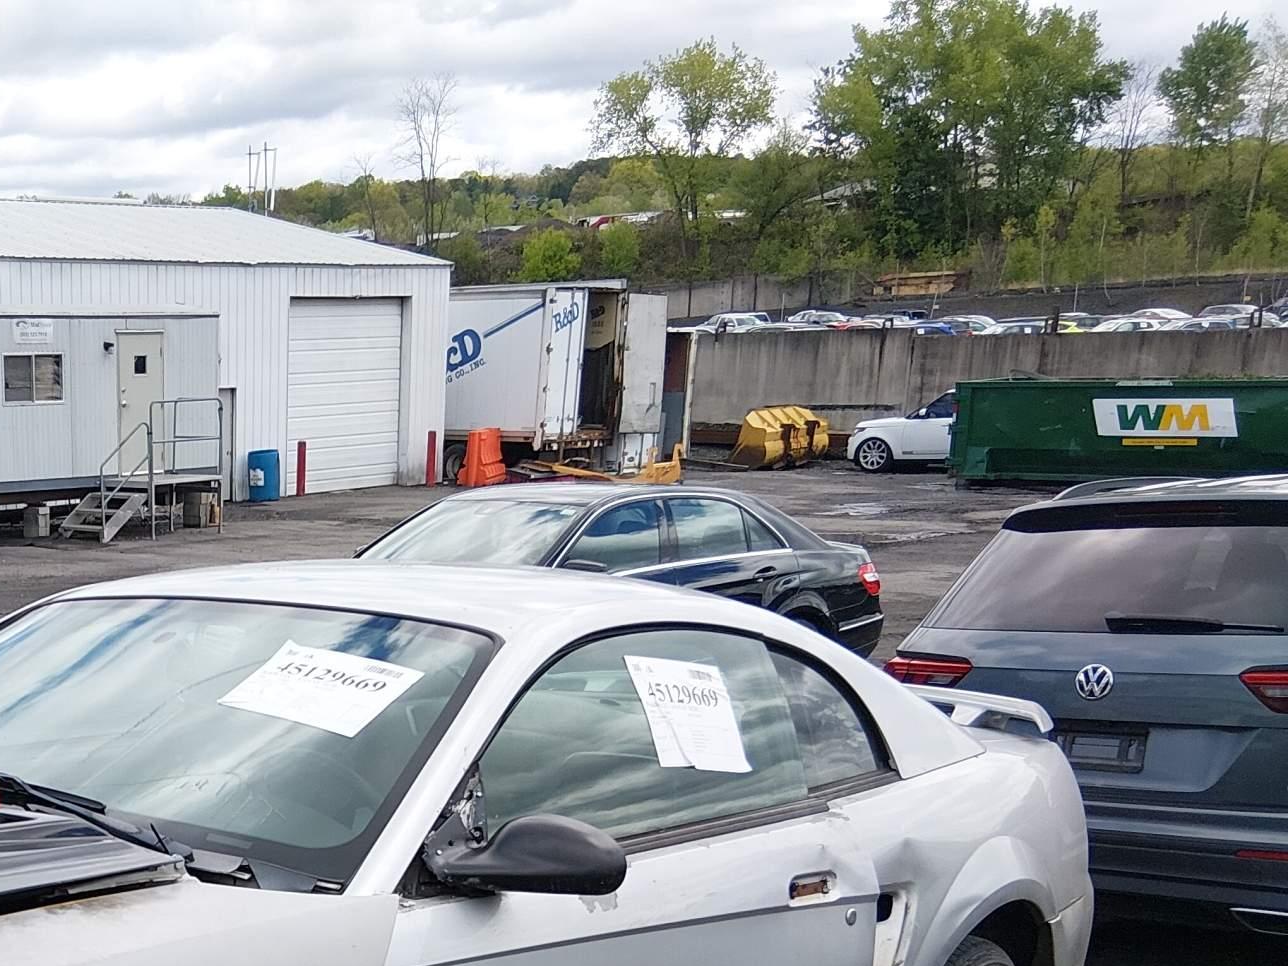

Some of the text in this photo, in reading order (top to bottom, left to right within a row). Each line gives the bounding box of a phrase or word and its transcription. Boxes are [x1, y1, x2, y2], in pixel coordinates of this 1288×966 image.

[552, 302, 580, 333] R&D
[1116, 404, 1210, 431] WM
[276, 662, 388, 693] 45129669
[1075, 664, 1113, 699] VW
[647, 680, 718, 708] 45129669
